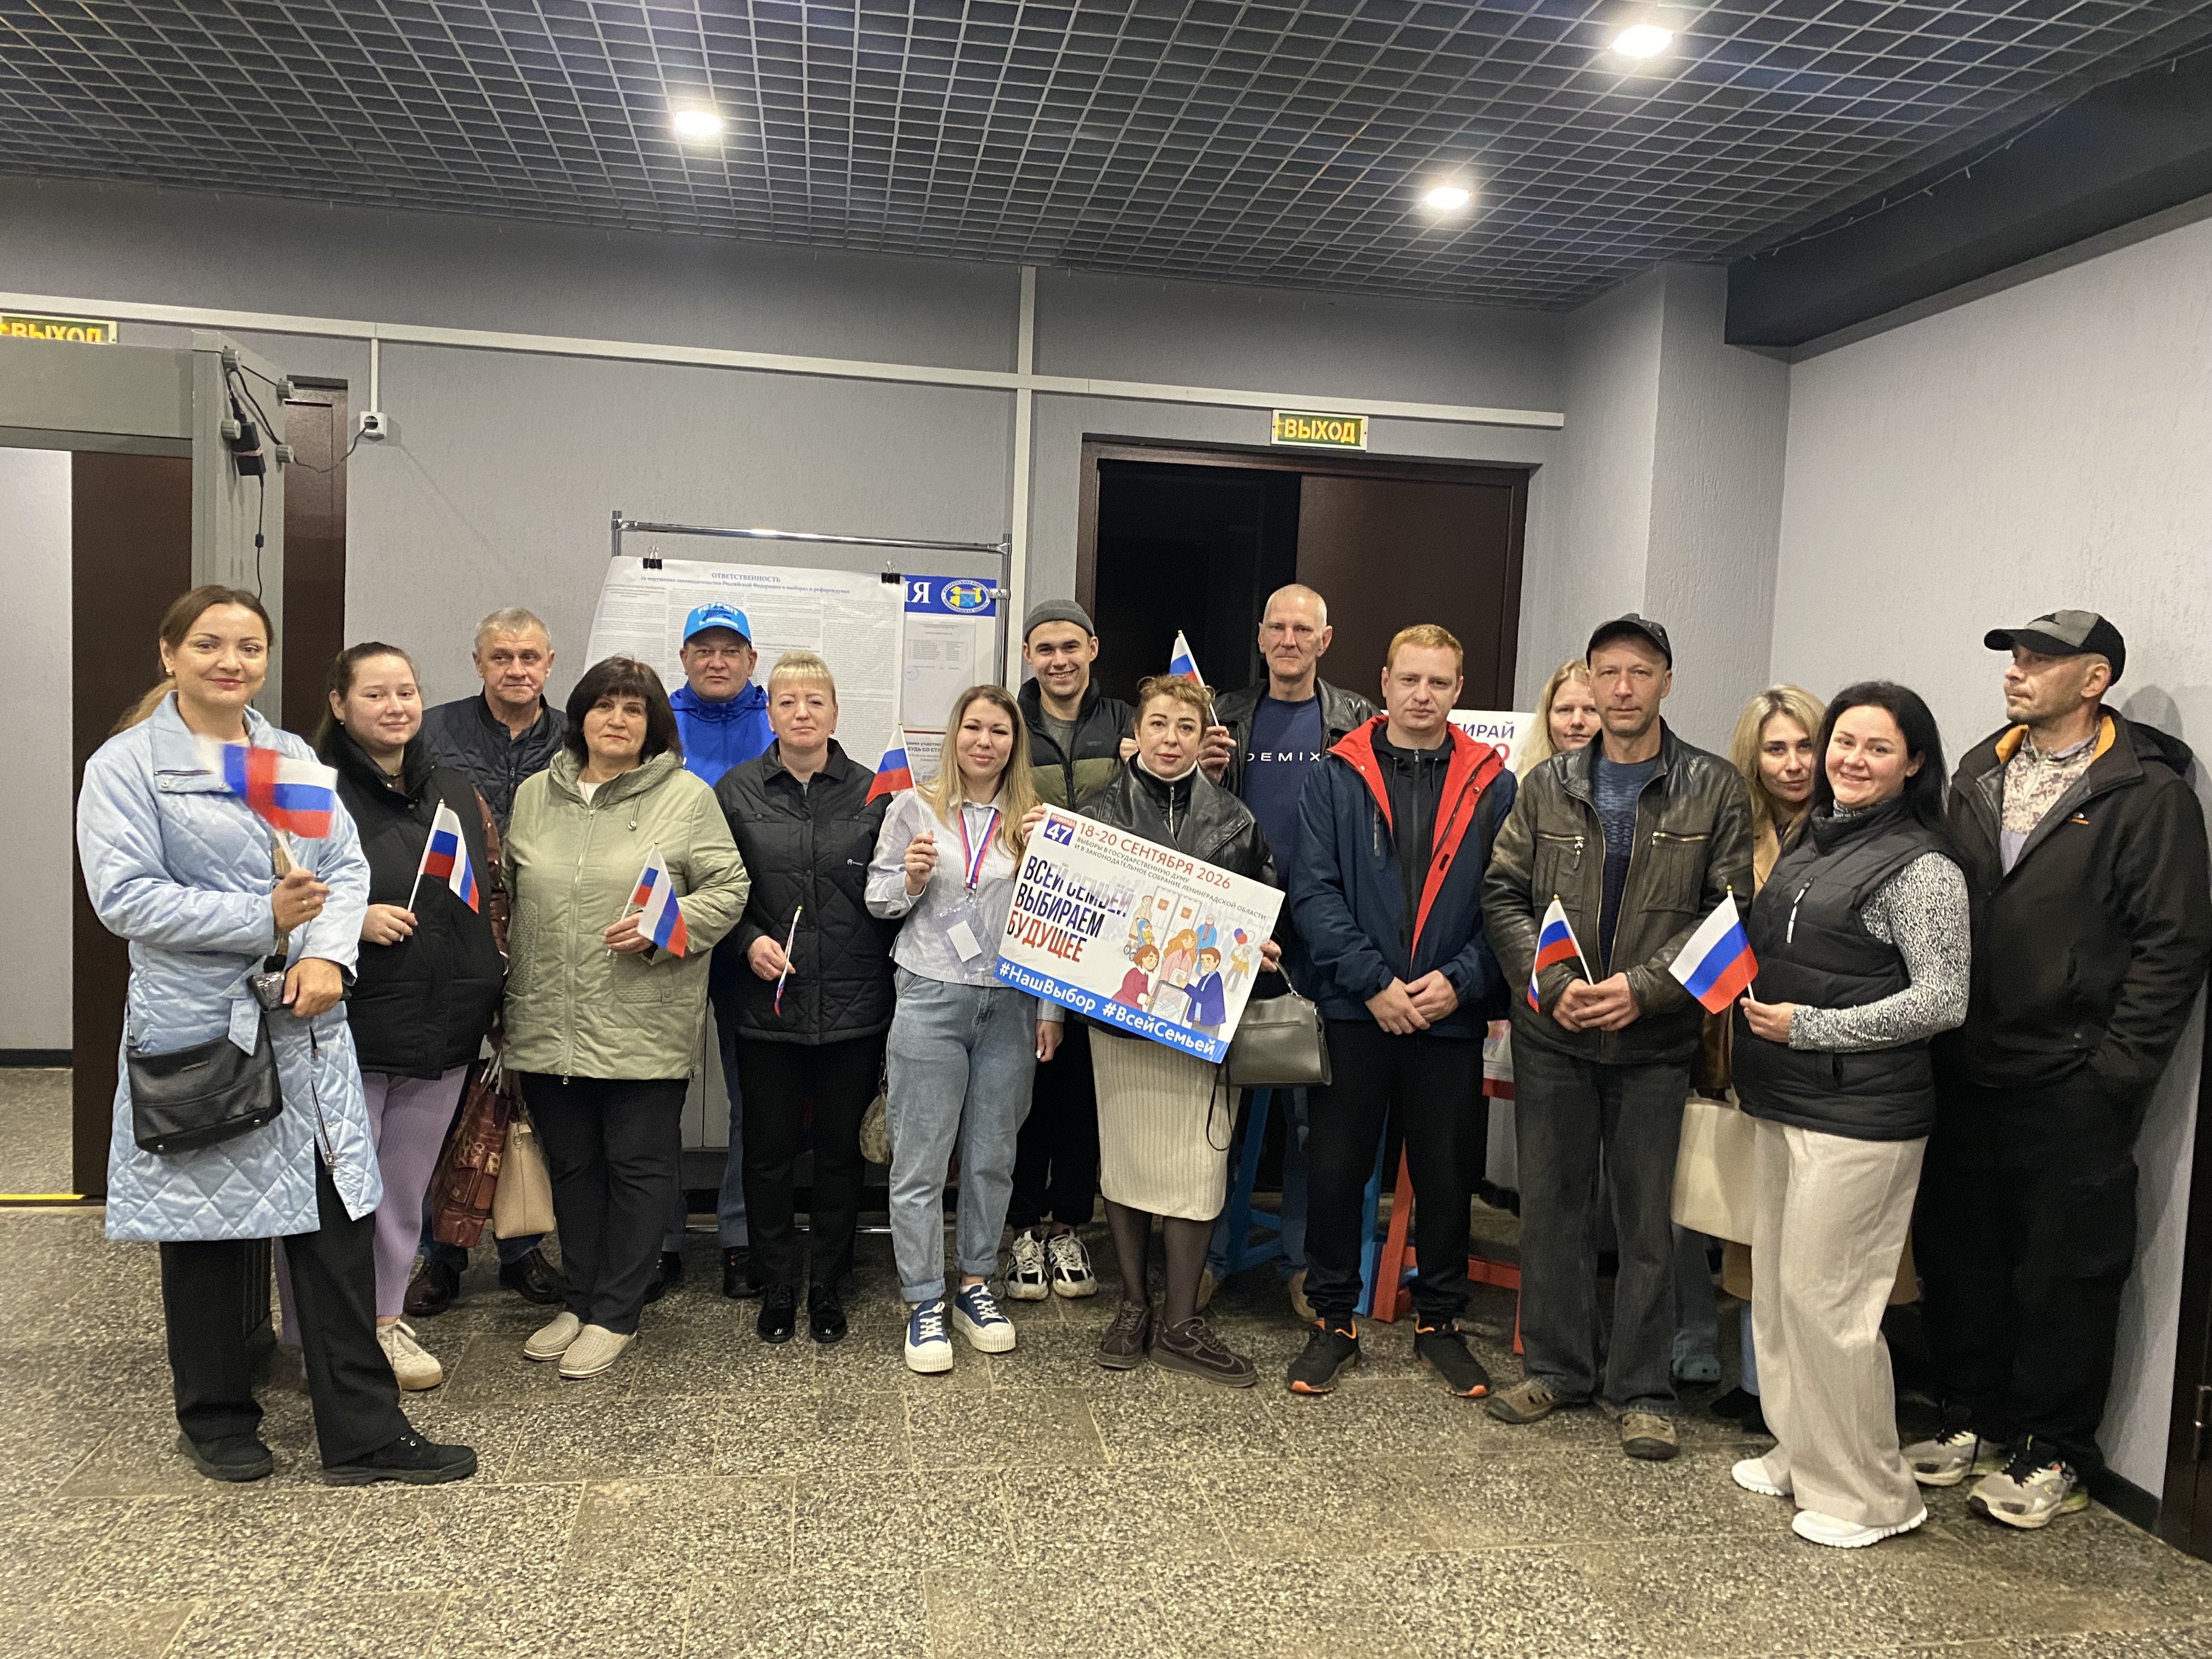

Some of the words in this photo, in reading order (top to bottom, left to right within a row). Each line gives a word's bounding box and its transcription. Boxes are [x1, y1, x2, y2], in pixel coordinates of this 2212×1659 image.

[1284, 419, 1356, 444] ВЫХОД
[712, 573, 780, 583] ОТВЕТСТВЕННОСТЬ
[698, 605, 709, 614] FC
[1247, 752, 1321, 762] DEMIX
[1047, 823, 1073, 843] 47
[1023, 855, 1069, 893] ВСЕЙ
[1077, 837, 1103, 851] ВЫБОРЫ
[1109, 849, 1171, 876] ГОСУДАРСТВЕННУЮ
[1170, 873, 1190, 883] ДУМУ
[1080, 823, 1117, 846] 18-20
[1121, 839, 1194, 876] СЕНТЯБРЯ
[1197, 867, 1231, 889] 2026
[1086, 848, 1147, 876] ЗАКОНОДАТЕЛЬНОЕ
[1148, 871, 1181, 888] СОБРАНИЕ
[1181, 884, 1236, 909] ЛЕНИНГРАДСКОЙ
[1237, 905, 1266, 921] ОБЛАСТИ
[1014, 882, 1105, 938] ВЫБИРАЕМ
[1007, 910, 1087, 963] БУДУЩЕЕ
[999, 961, 1096, 1011] #НашВыбор
[1102, 1002, 1216, 1056] #ВсейСемьей
